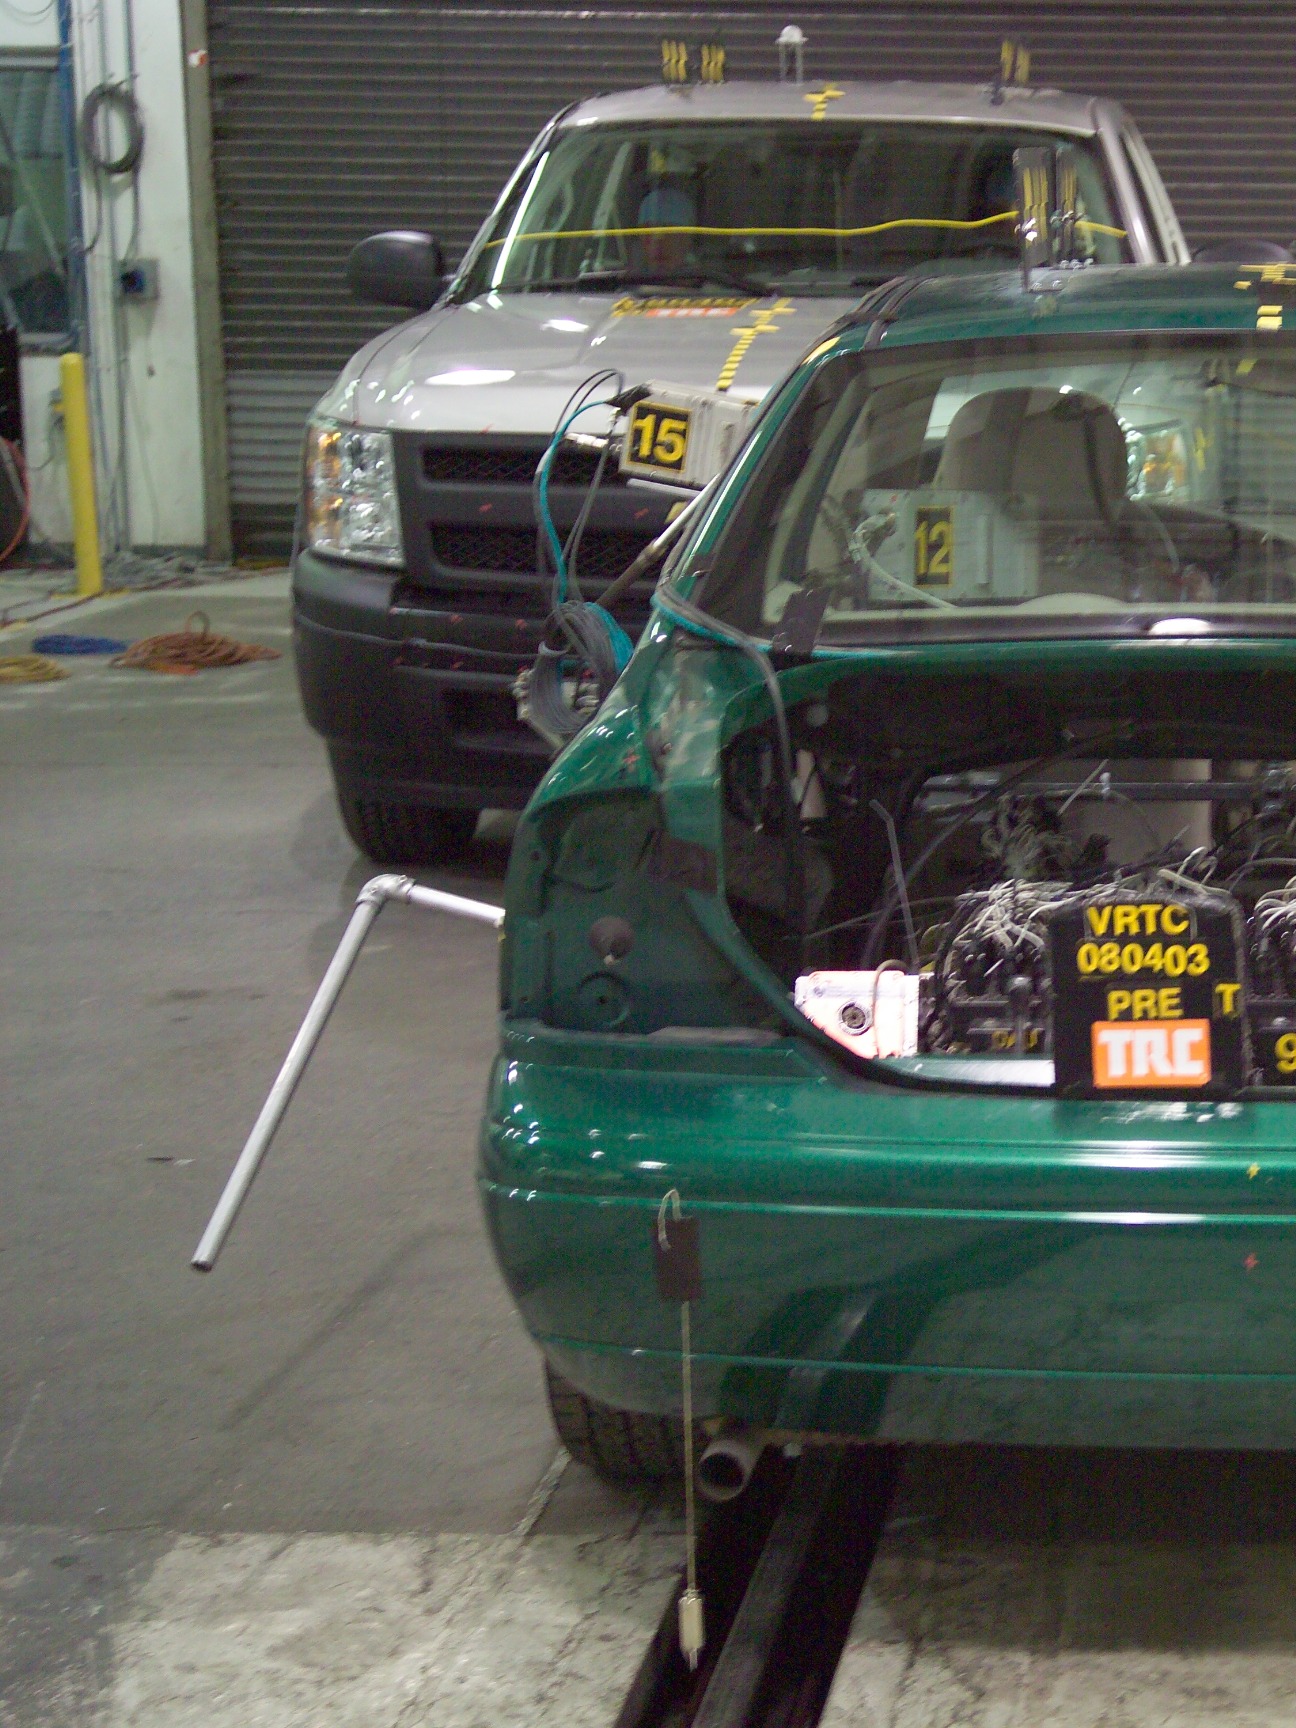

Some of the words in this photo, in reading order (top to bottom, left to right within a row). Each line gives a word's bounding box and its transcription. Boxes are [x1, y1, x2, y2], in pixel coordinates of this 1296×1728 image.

[632, 413, 689, 464] 15
[913, 520, 952, 575] 12
[1085, 903, 1191, 937] VRTC
[1076, 942, 1211, 978] 080403
[1106, 986, 1185, 1021] PRE
[1214, 982, 1242, 1017] T
[1099, 1028, 1206, 1078] TRC
